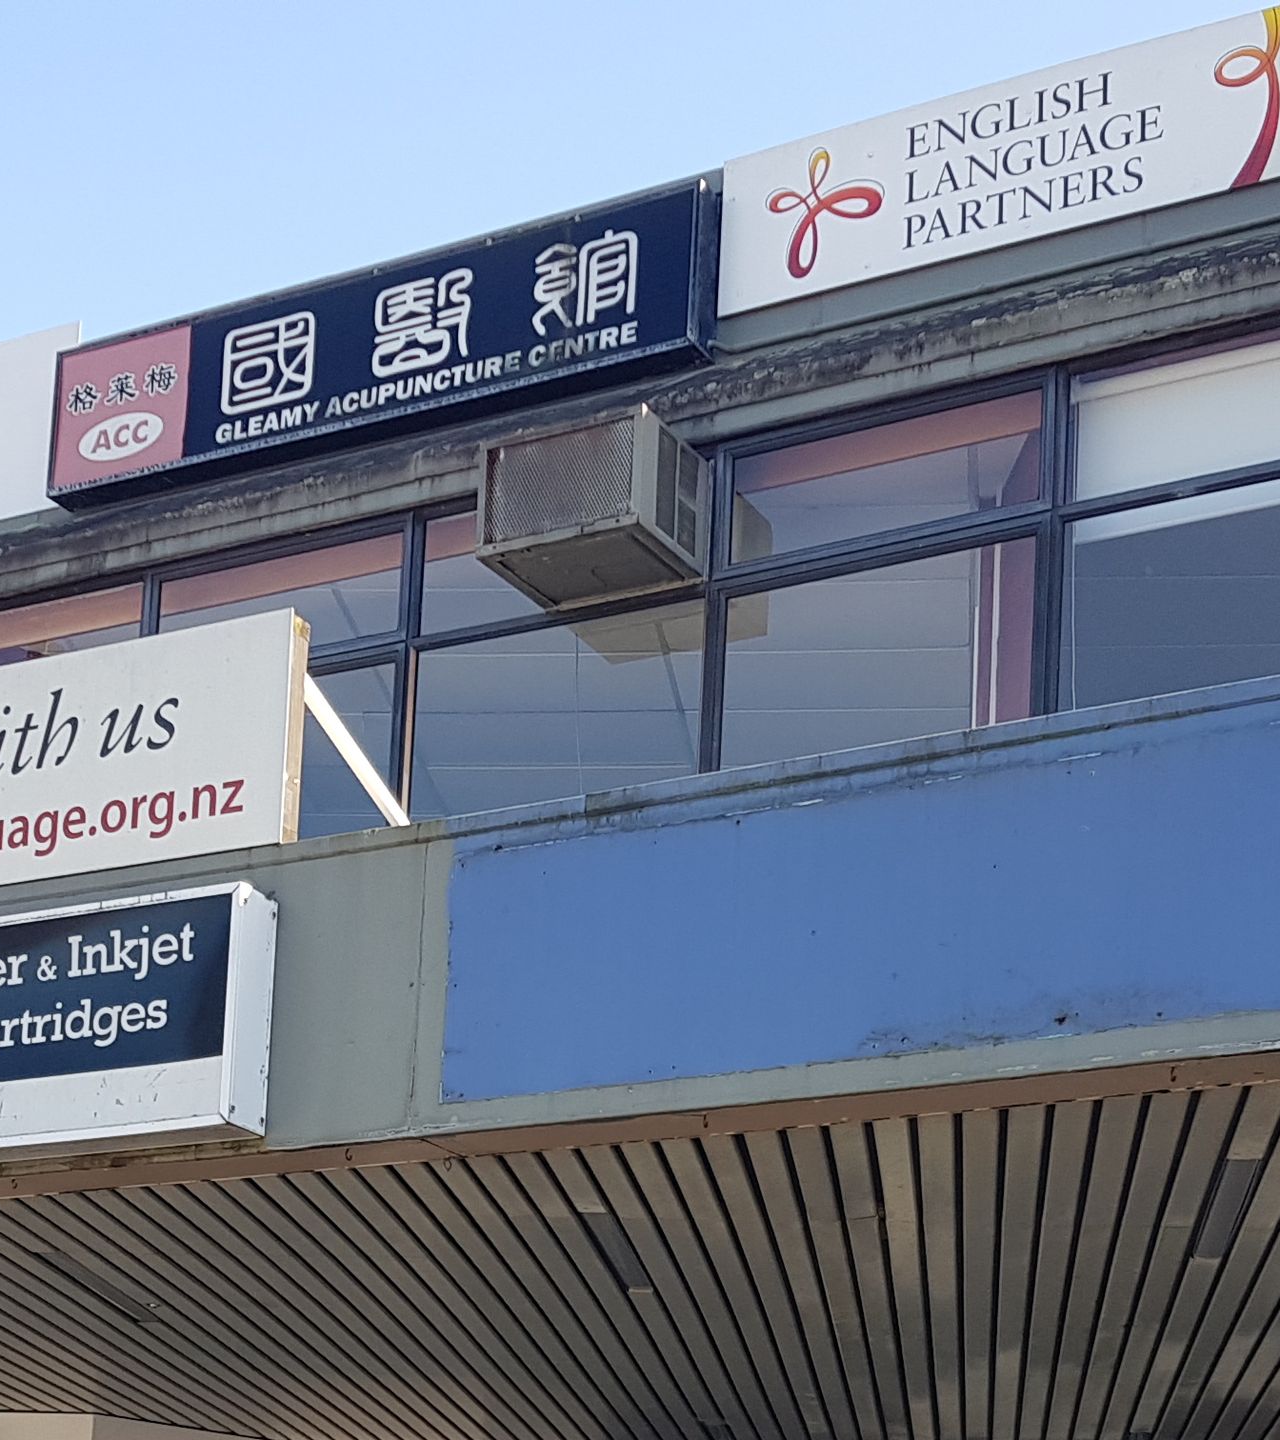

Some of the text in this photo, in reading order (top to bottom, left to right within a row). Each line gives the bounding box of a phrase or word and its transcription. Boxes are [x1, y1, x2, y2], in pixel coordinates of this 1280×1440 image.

[906, 71, 1114, 161] ENGLISH
[906, 105, 1165, 204] LANGUAGE
[902, 155, 1145, 251] PARTNERS
[215, 321, 638, 444] GLEAMY ACUPUNCTURE CENTRE
[91, 420, 149, 453] ACC
[98, 695, 180, 758] us
[37, 956, 58, 982] &
[67, 922, 195, 990] Inkjet
